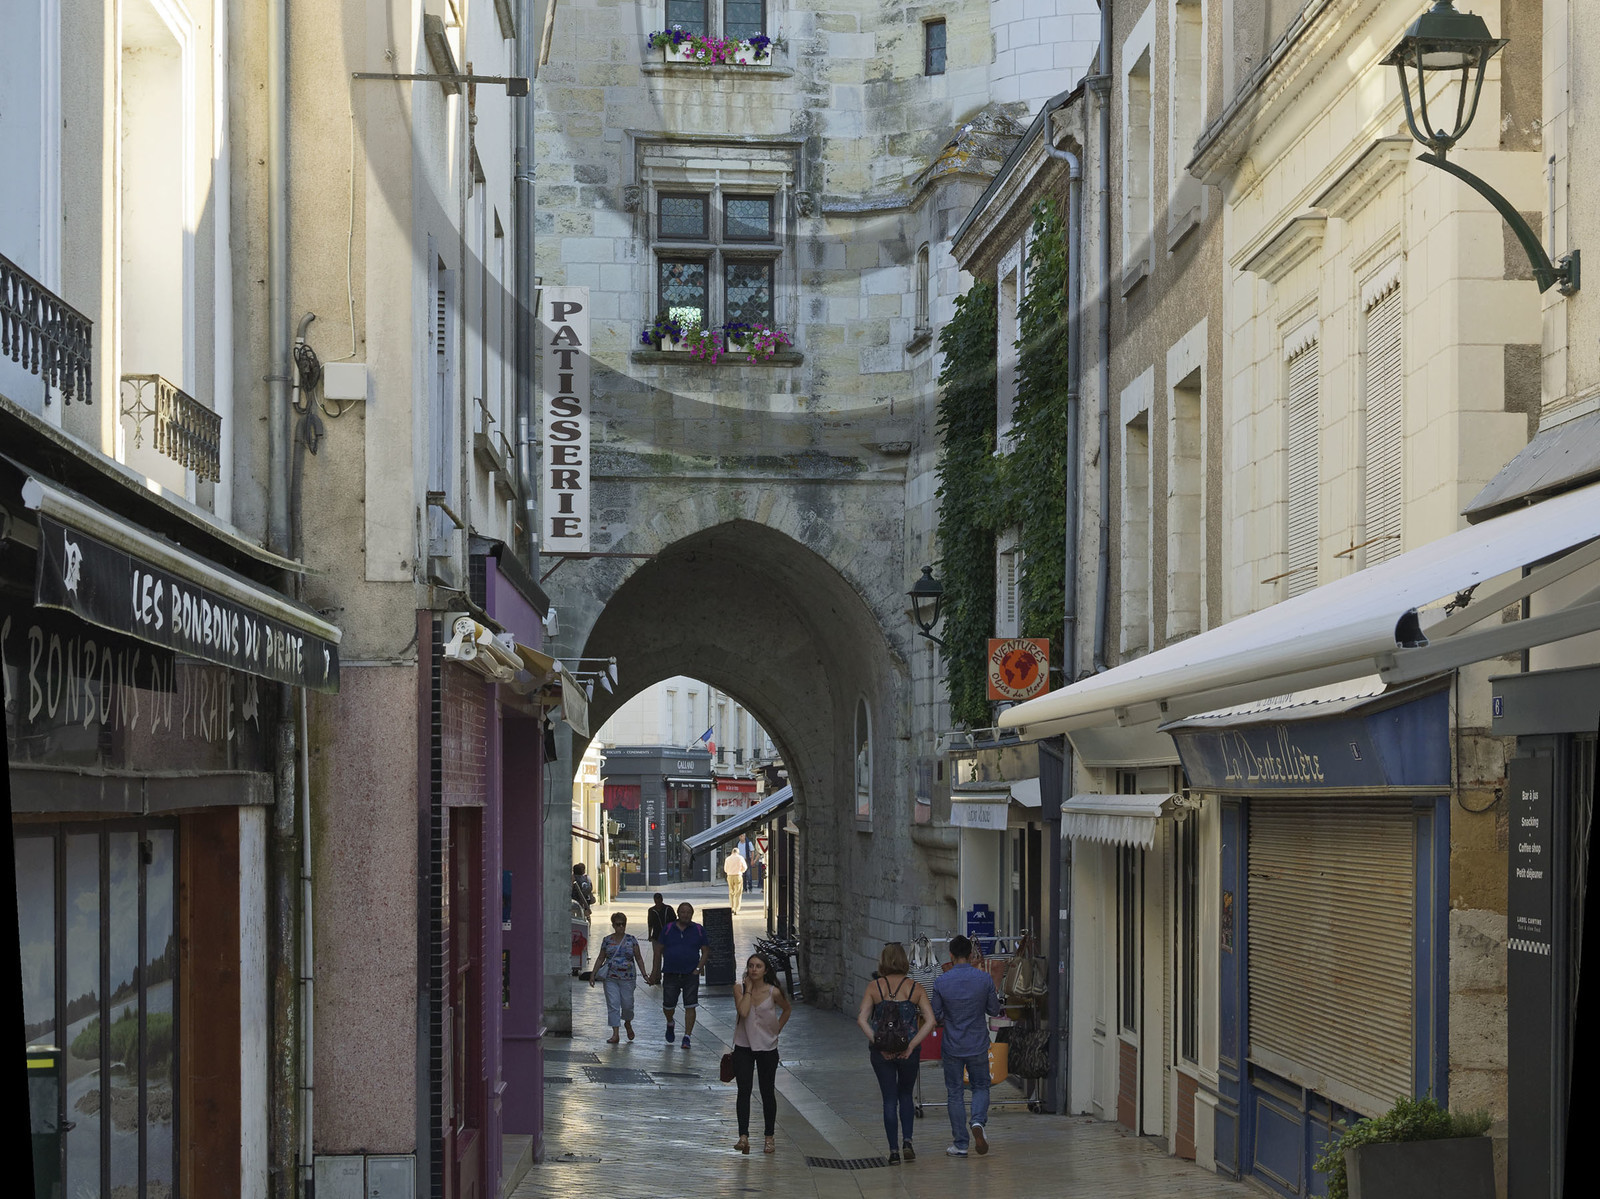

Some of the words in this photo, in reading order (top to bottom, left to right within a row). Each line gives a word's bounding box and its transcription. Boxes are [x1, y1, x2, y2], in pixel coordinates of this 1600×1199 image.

[549, 301, 583, 538] PATISSERIE
[132, 569, 164, 631] LES
[171, 583, 240, 657] BONBONS
[244, 615, 260, 662] DU
[265, 624, 304, 674] PIRATE
[992, 639, 1048, 665] AVENTURES
[28, 624, 140, 732] BONBONS
[150, 654, 174, 735] DU
[182, 661, 236, 744] PIRATE
[991, 672, 1011, 695] Objets
[1012, 689, 1024, 698] du
[1025, 672, 1045, 696] Monde
[1494, 698, 1501, 715] 6
[1219, 730, 1243, 780] La
[1232, 724, 1325, 781] Dentellière
[1521, 790, 1529, 800] Bar
[1521, 816, 1539, 828] Snacking
[1518, 842, 1531, 853] Coffee
[1531, 842, 1541, 855] shop
[1516, 867, 1526, 878] Petit
[1526, 868, 1543, 881] déjeuner
